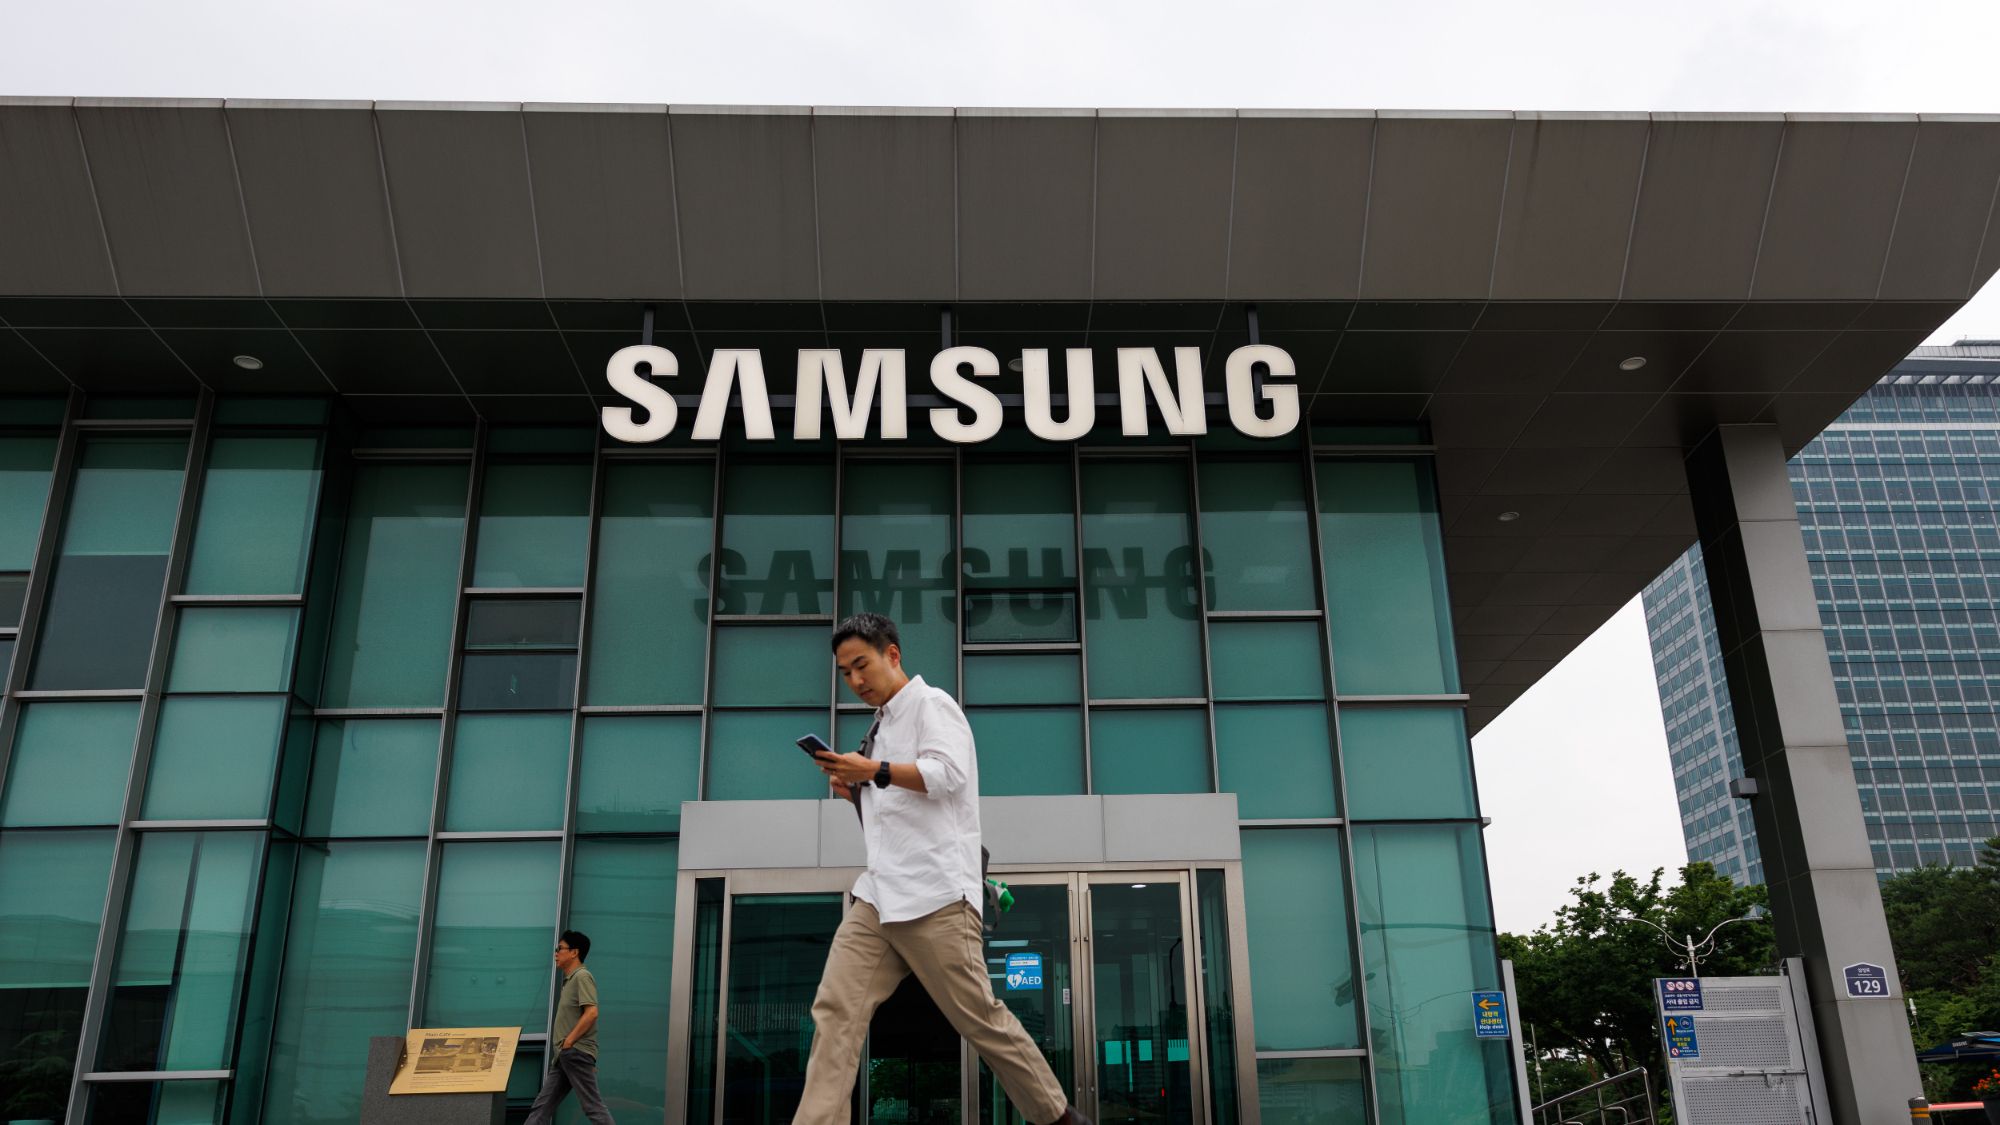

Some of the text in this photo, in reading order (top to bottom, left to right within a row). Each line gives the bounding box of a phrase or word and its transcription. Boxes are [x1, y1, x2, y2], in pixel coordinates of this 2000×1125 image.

[601, 344, 1300, 443] SAMSUNG
[694, 544, 1216, 626] SAMSUNG
[1022, 976, 1042, 985] AED
[1854, 979, 1881, 993] 129
